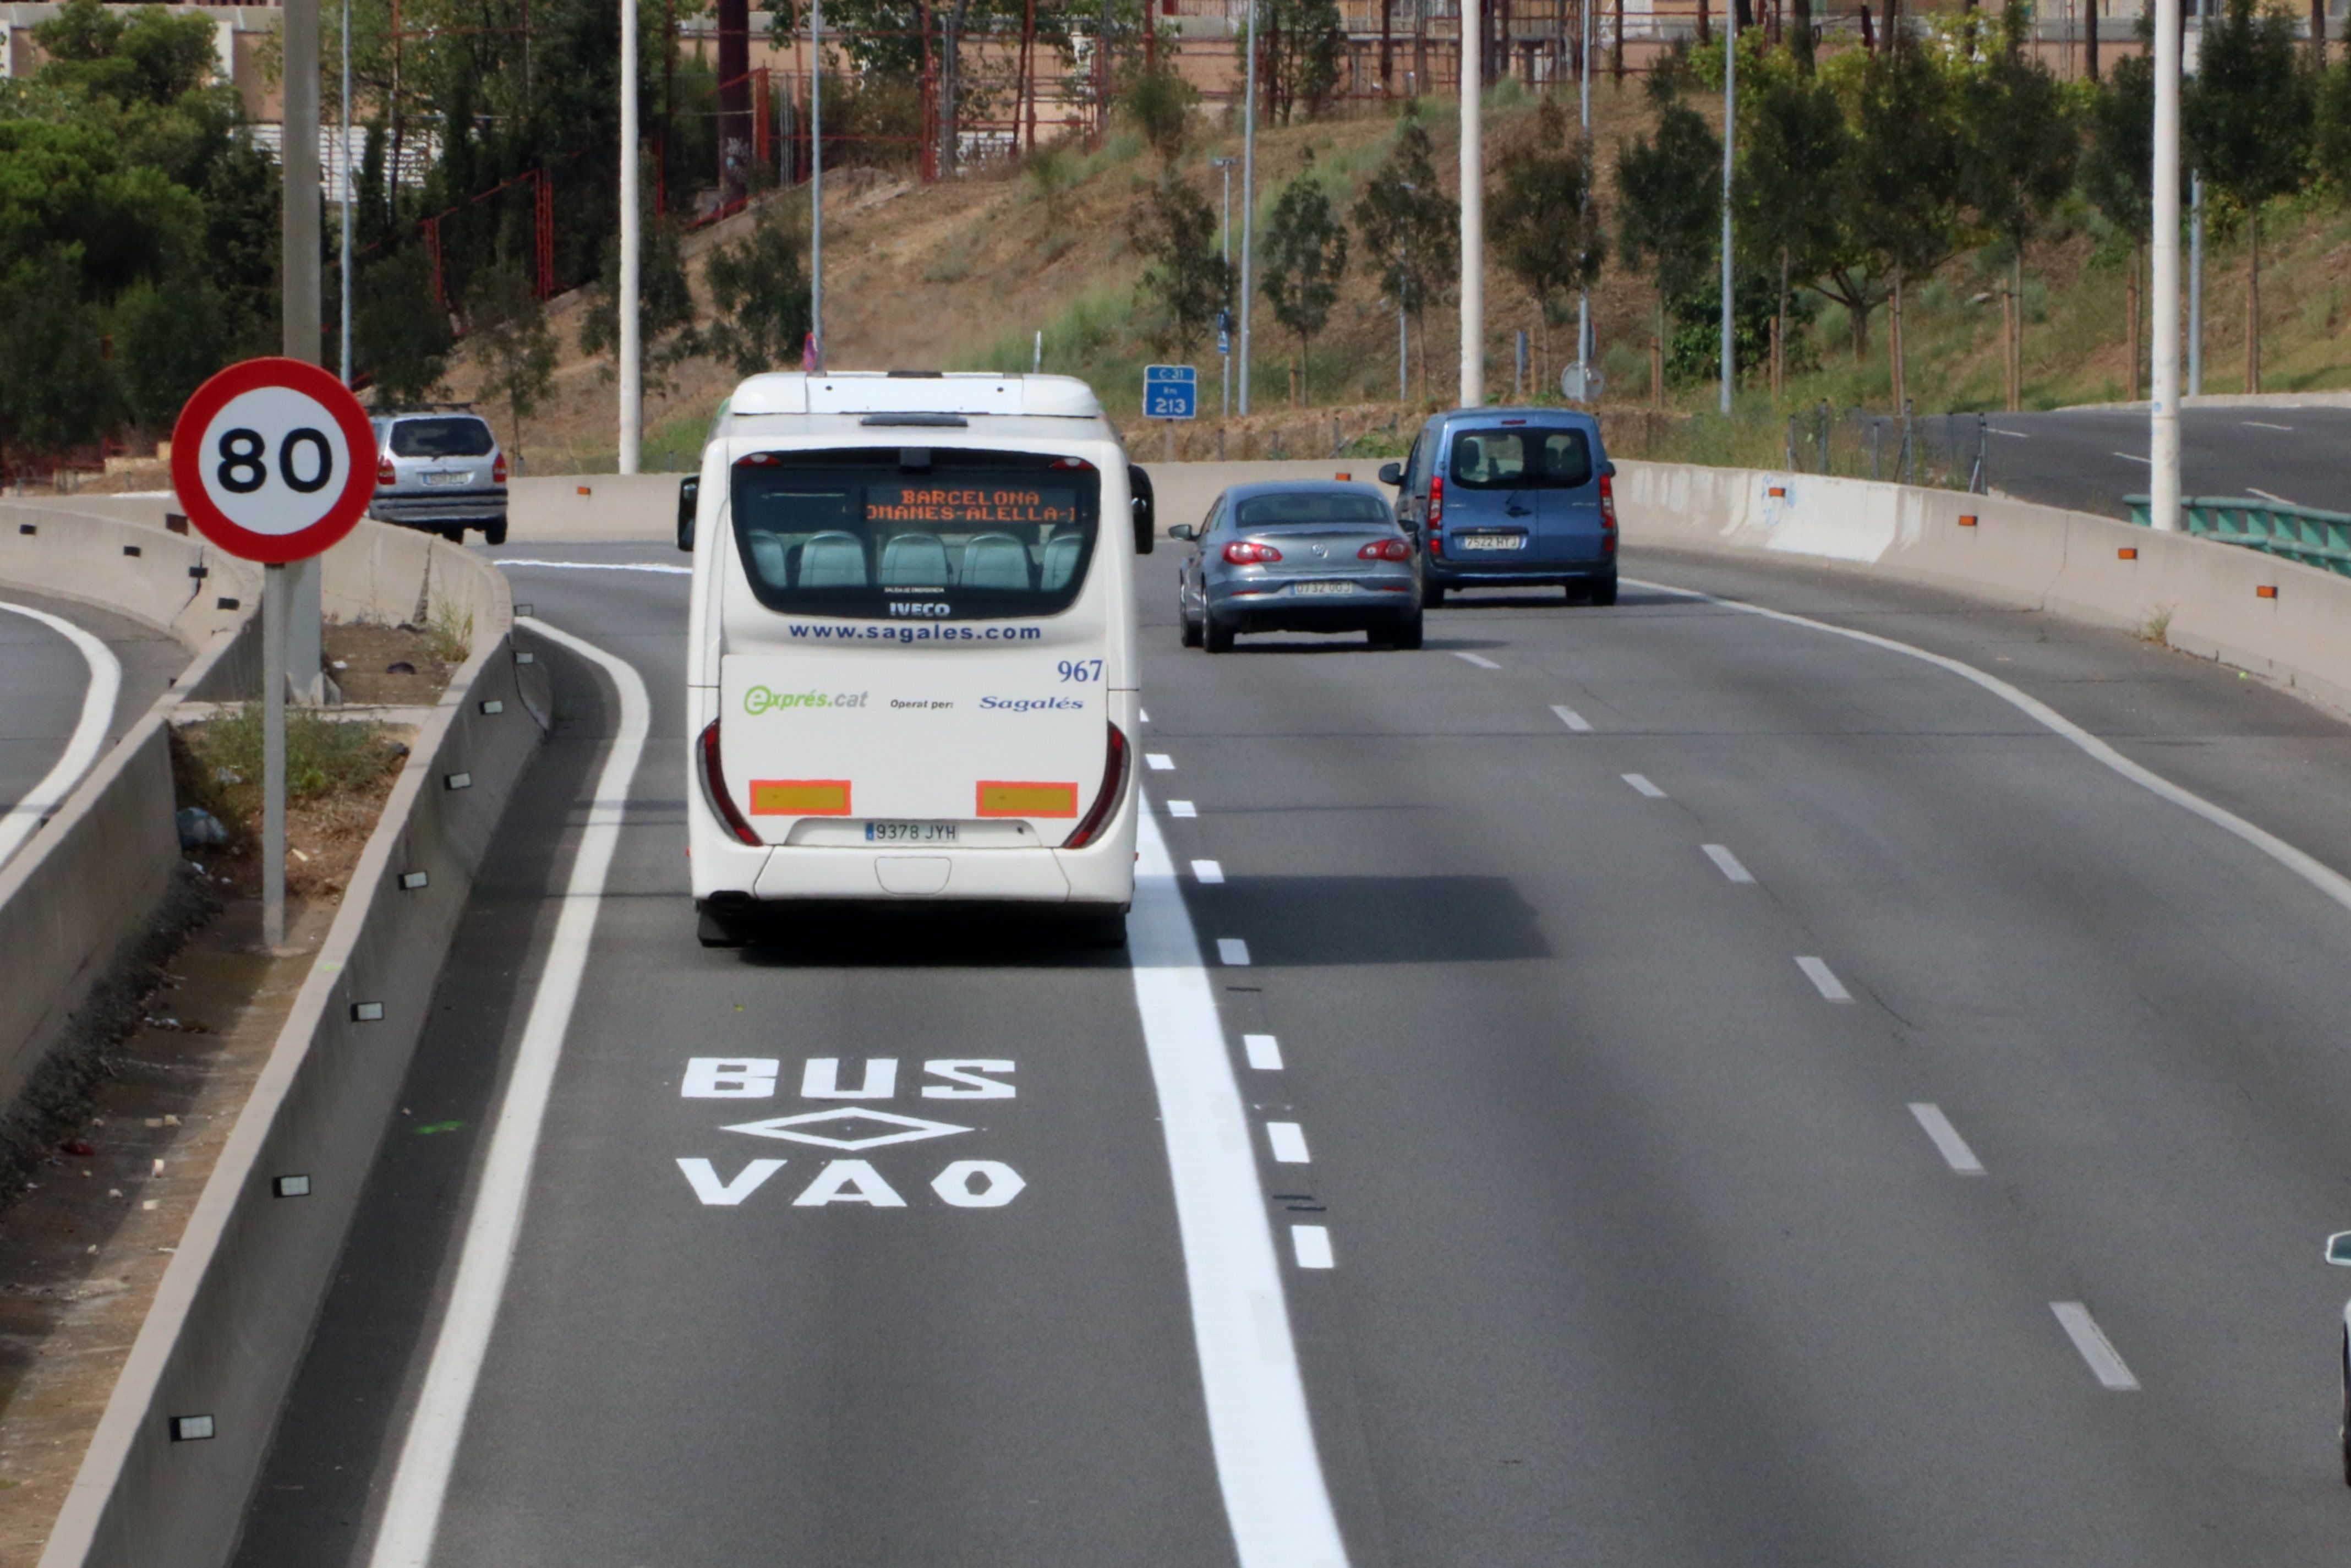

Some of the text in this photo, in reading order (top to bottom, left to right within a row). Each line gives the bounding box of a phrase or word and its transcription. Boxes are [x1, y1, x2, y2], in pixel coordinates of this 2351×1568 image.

[1156, 397, 1186, 413] 213
[218, 428, 332, 493] 80
[901, 490, 1040, 505] BARCELONA
[889, 602, 950, 616] IVECO
[789, 624, 1041, 643] www.sagales.com
[1058, 660, 1103, 682] 967
[890, 700, 953, 709] Operat per:
[980, 696, 1084, 712] Sagalés
[877, 824, 956, 839] 9378 JYH
[681, 1057, 1016, 1099] BUS
[676, 1159, 1027, 1208] VAO
